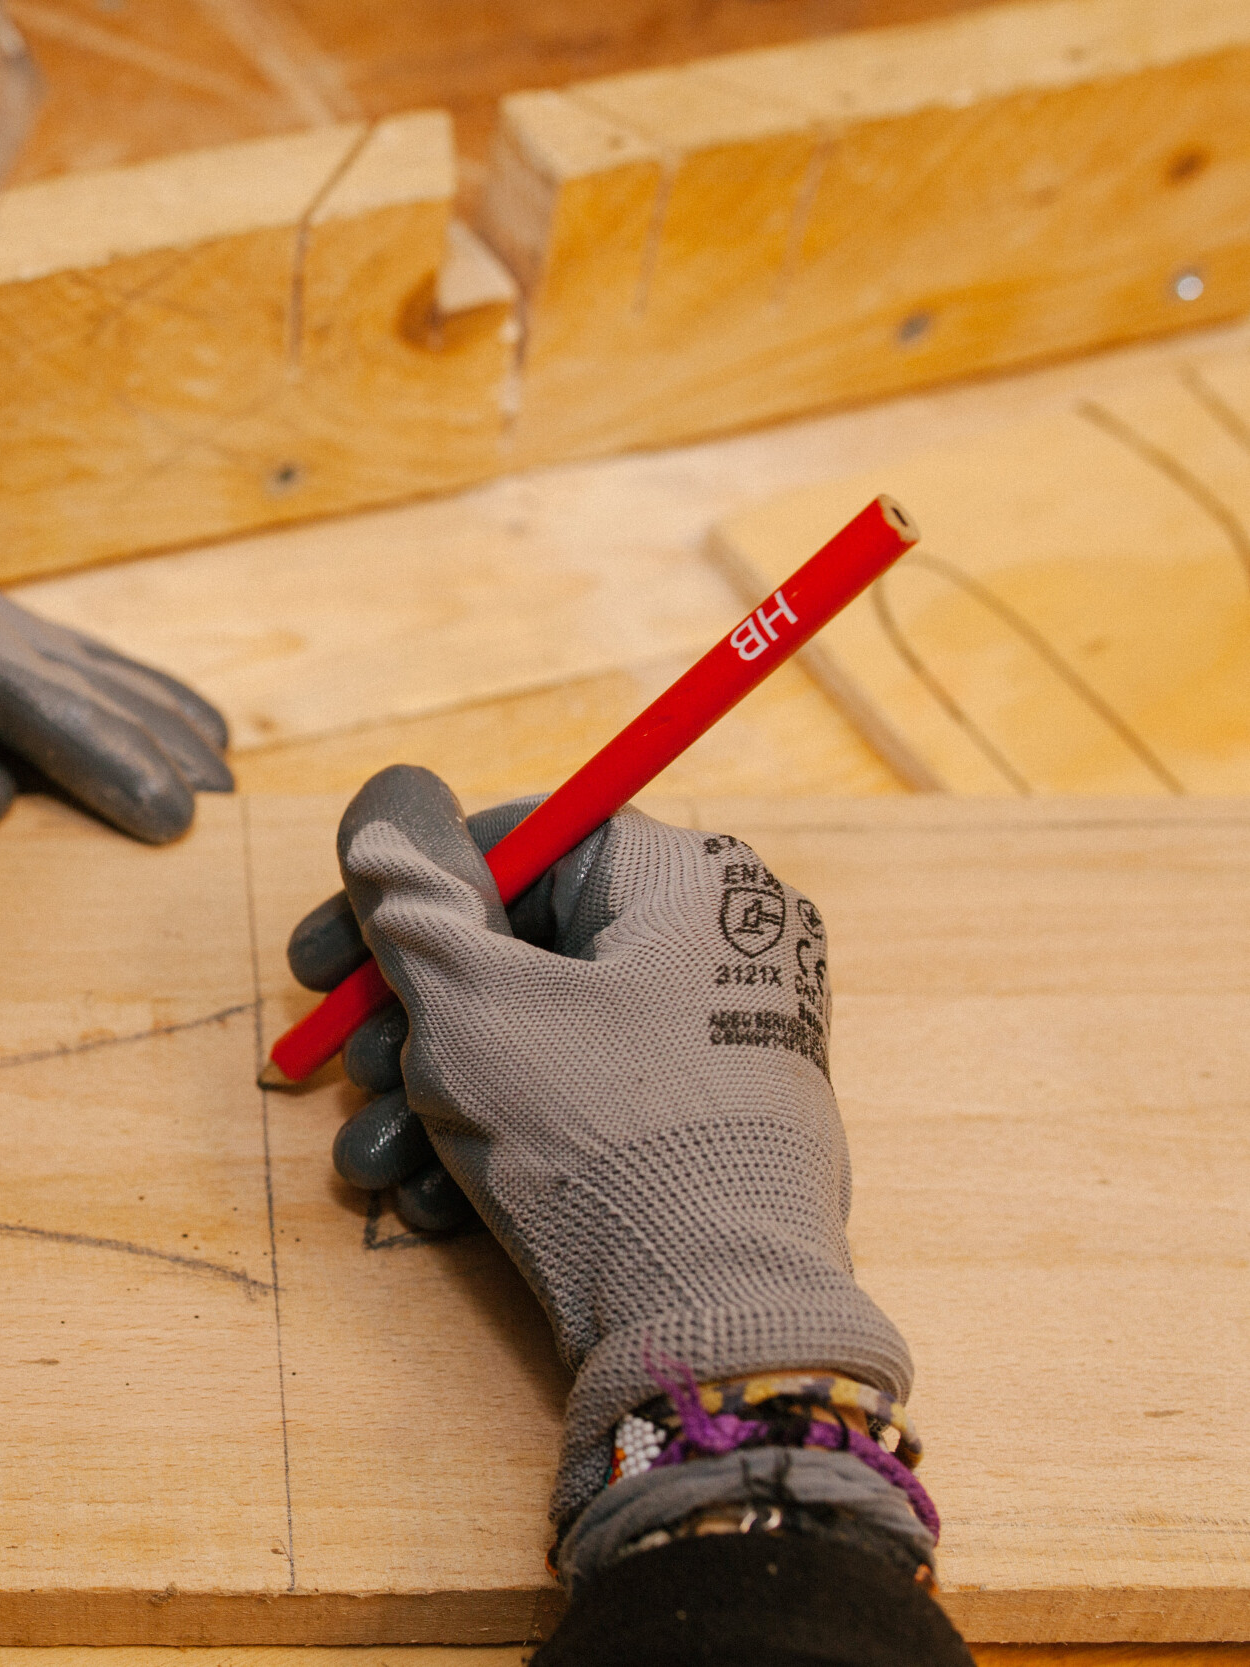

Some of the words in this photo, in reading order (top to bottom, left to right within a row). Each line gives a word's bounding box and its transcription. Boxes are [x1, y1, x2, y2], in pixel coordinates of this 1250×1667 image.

[730, 590, 799, 661] HB
[724, 864, 758, 884] EN
[715, 964, 783, 987] 3121X
